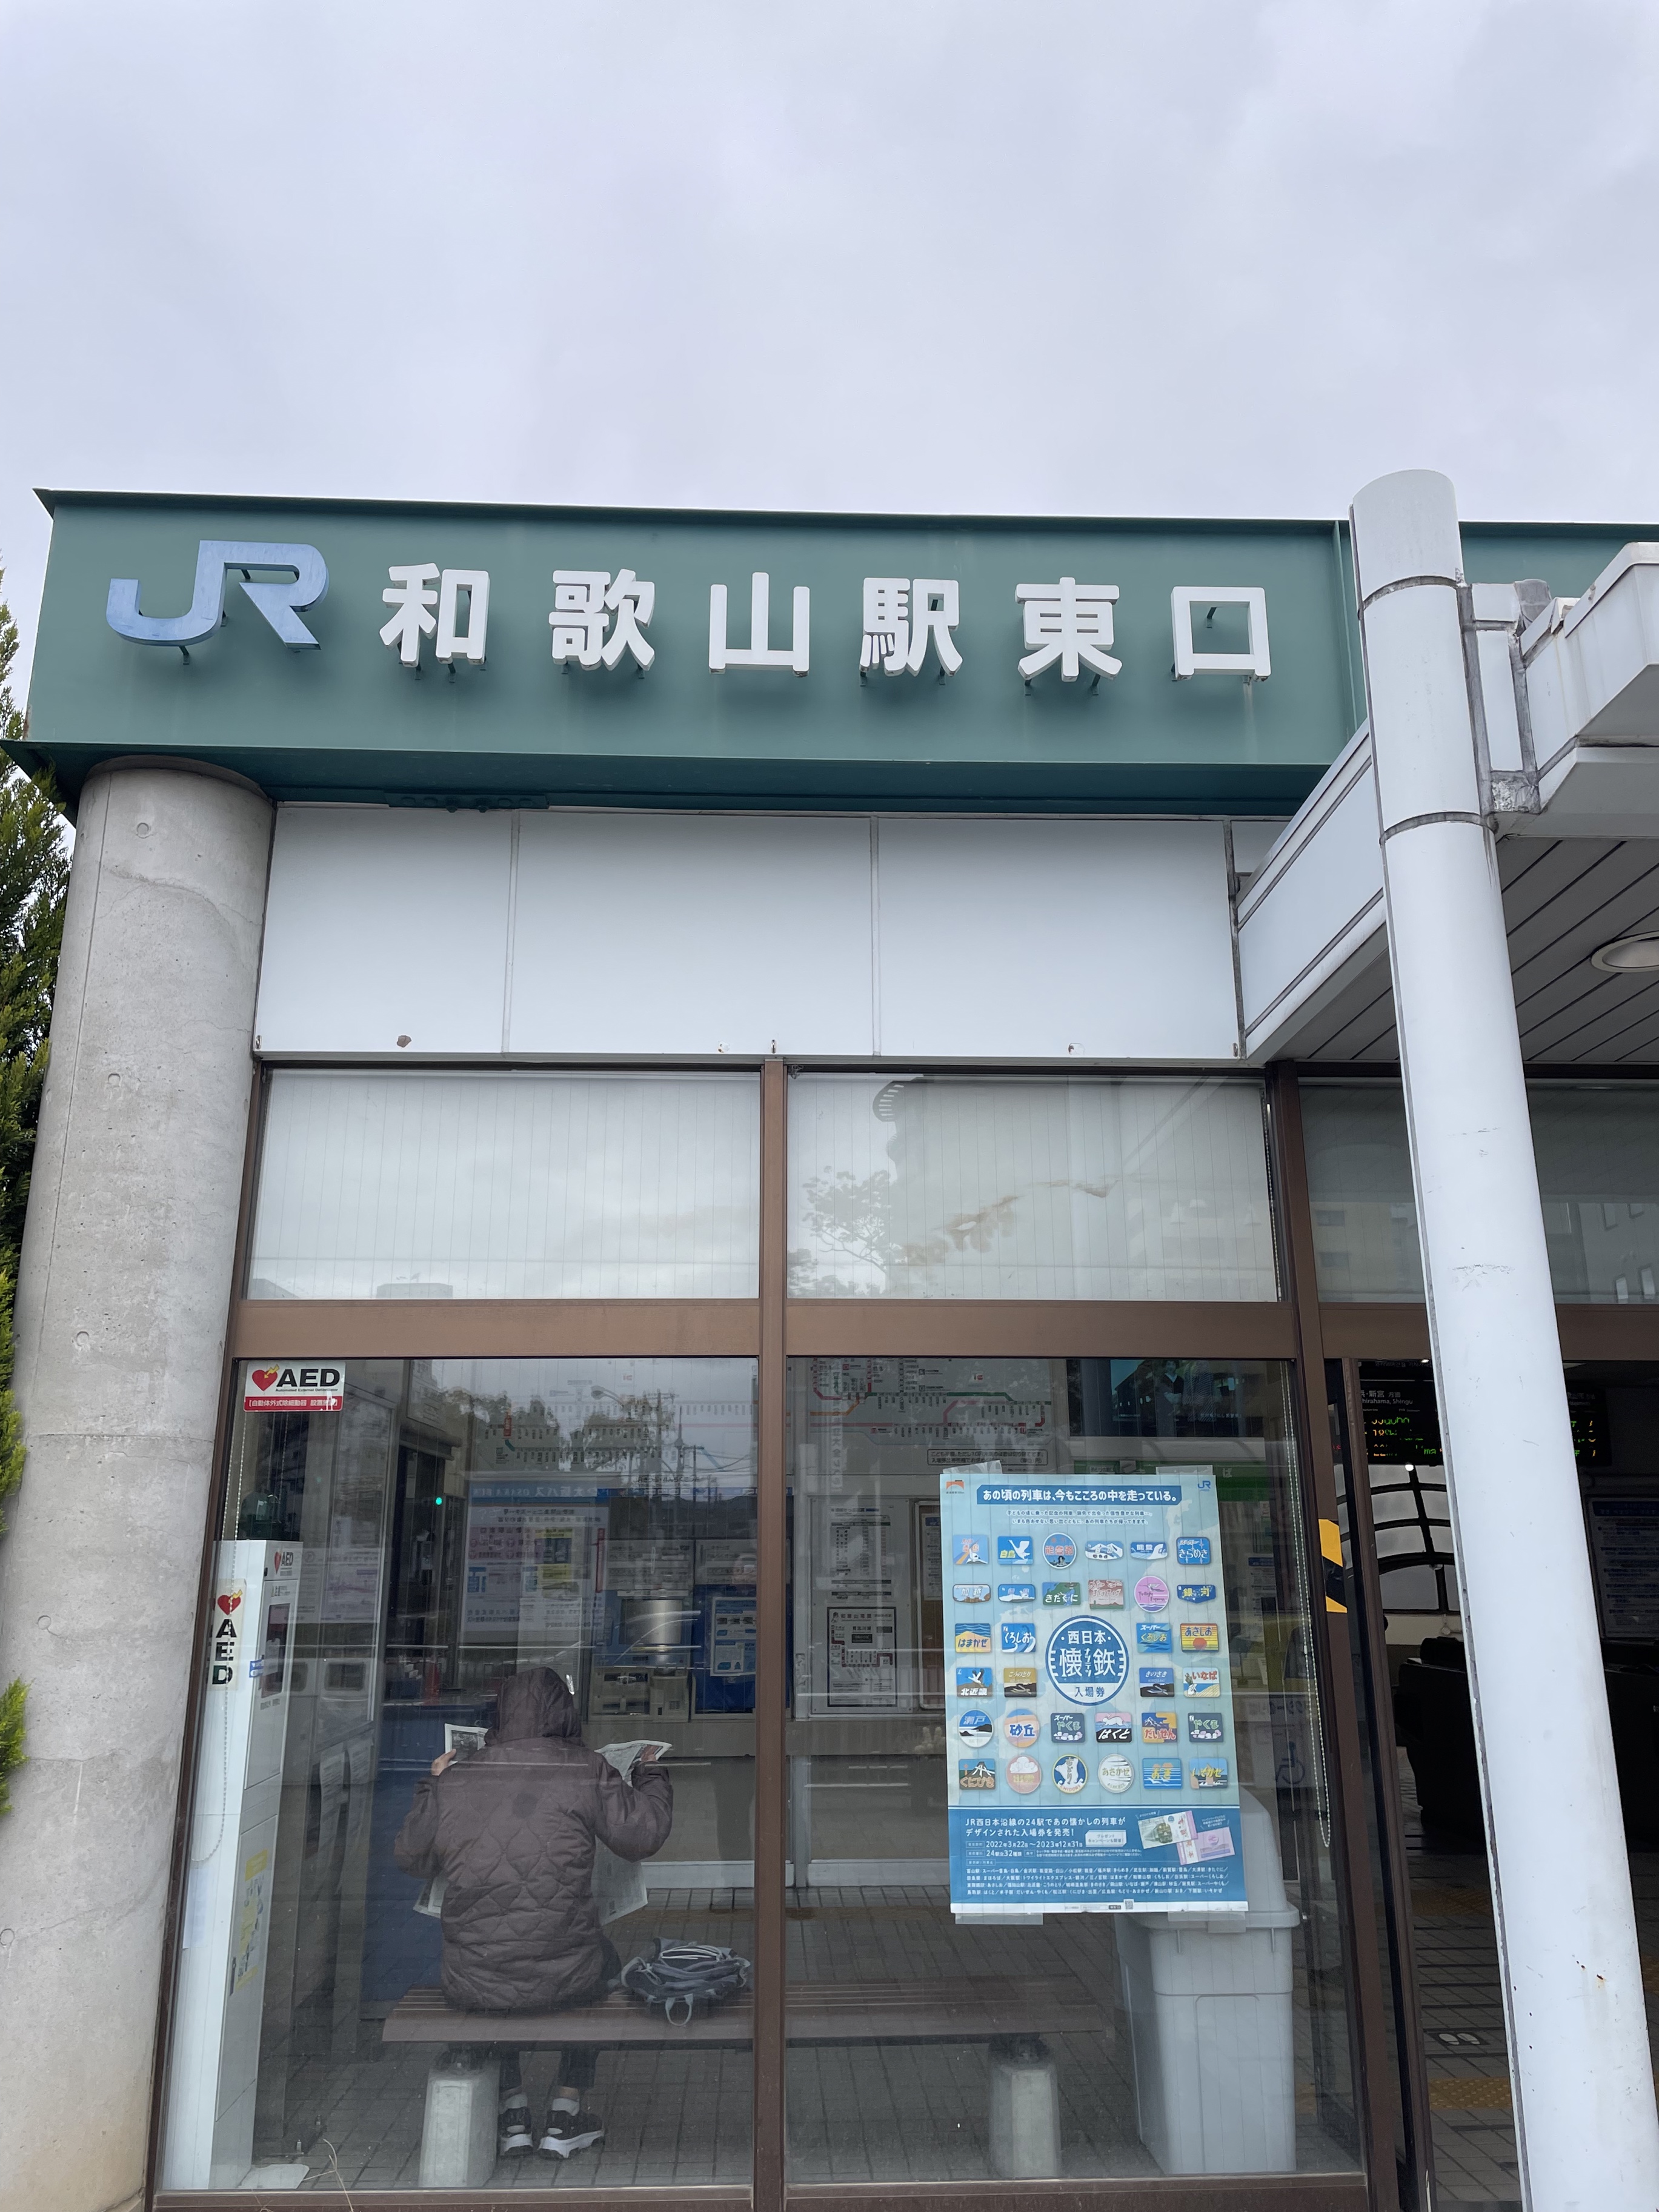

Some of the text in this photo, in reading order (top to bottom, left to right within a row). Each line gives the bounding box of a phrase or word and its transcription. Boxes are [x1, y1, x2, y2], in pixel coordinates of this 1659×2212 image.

[106, 540, 1271, 682] JR 和歌山駅東口
[276, 1369, 340, 1387] AED
[1197, 1480, 1211, 1489] JR
[982, 1489, 1177, 1501] あの頃の列車は、今もこころの中を走っている。
[281, 1552, 294, 1566] AED
[1179, 1549, 1208, 1559] きらめき
[1004, 1632, 1032, 1643] くろしお
[1140, 1632, 1168, 1642] くろしお
[958, 1638, 988, 1648] はまかぜ
[211, 1619, 238, 1685] AED
[1192, 1670, 1218, 1680] いなば
[1074, 1686, 1105, 1698] 入場券
[1056, 1721, 1081, 1731] やくも
[1194, 1719, 1220, 1729] やくも
[1009, 1724, 1035, 1736] 砂丘
[1098, 1729, 1131, 1739] はくと
[1144, 1729, 1177, 1740] だいせん
[1102, 1767, 1131, 1777] あさかぜ
[1151, 1768, 1172, 1780] おき
[1192, 1768, 1225, 1778] いそかぜ
[960, 1776, 995, 1789] くにびき
[965, 1816, 1126, 1827] JR西日本沿線の24駅であの懐かしの列車が
